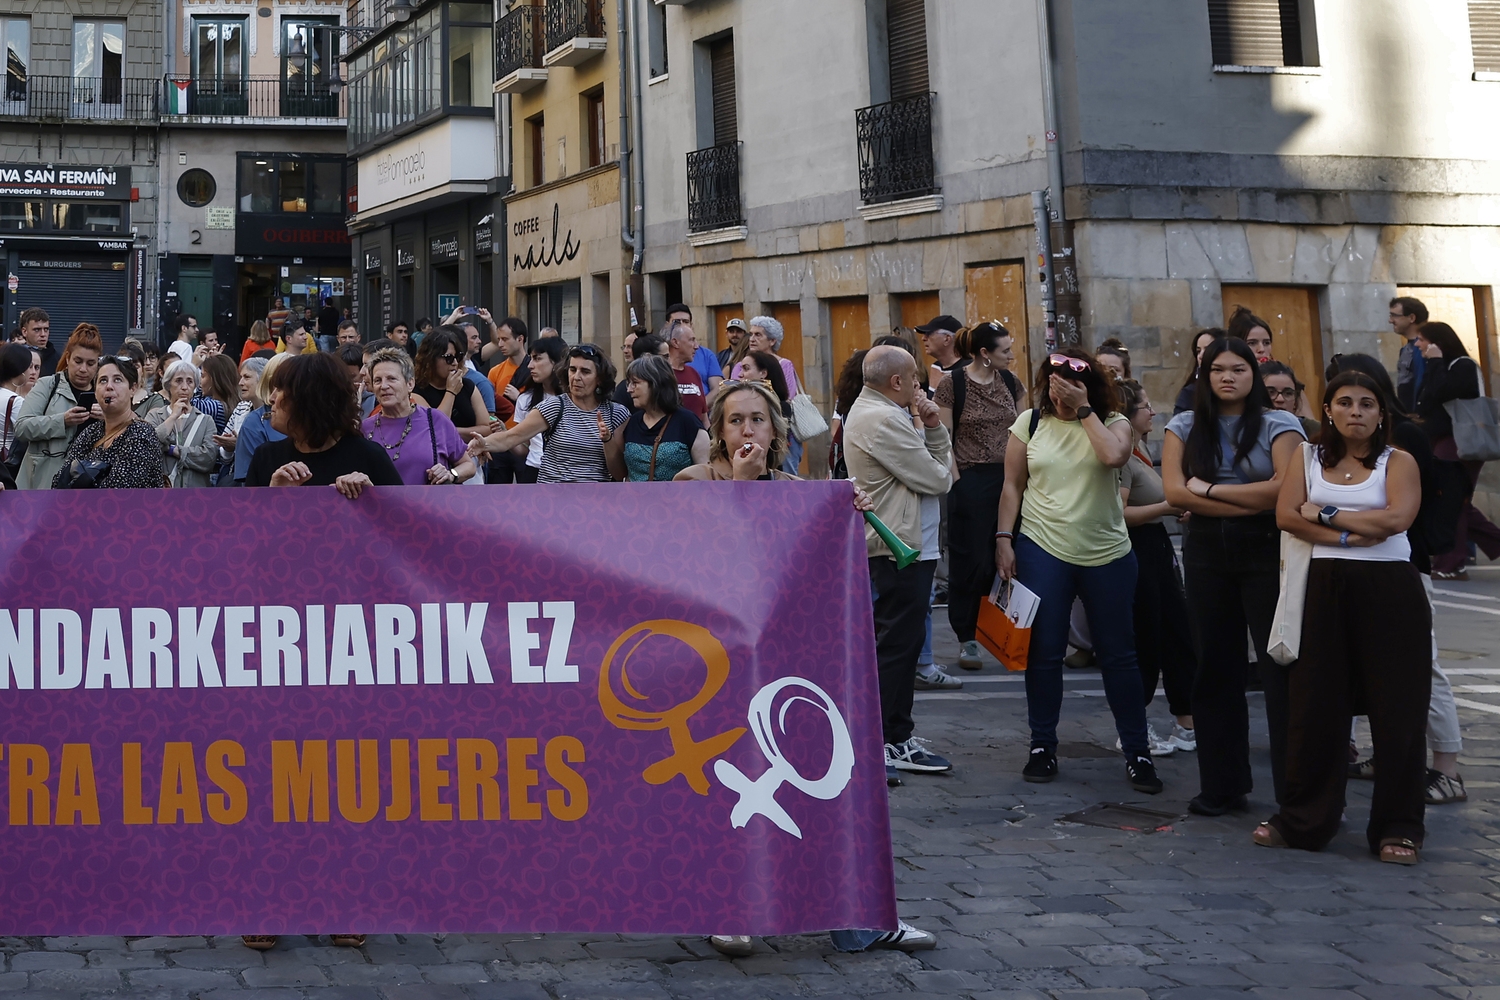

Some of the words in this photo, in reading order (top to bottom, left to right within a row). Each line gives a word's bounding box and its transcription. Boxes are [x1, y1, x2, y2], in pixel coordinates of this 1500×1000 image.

[24, 171, 54, 183] SAN
[60, 168, 116, 185] FERMÍN!
[263, 228, 352, 244] OGIBERR
[514, 216, 540, 236] COFFEE
[191, 230, 202, 244] 2
[514, 202, 581, 272] nails
[775, 262, 802, 287] The
[870, 252, 914, 285] Shop
[445, 298, 455, 309] H
[507, 601, 580, 683] EZ
[122, 740, 248, 825] LAS
[271, 736, 589, 823] MUJERES
